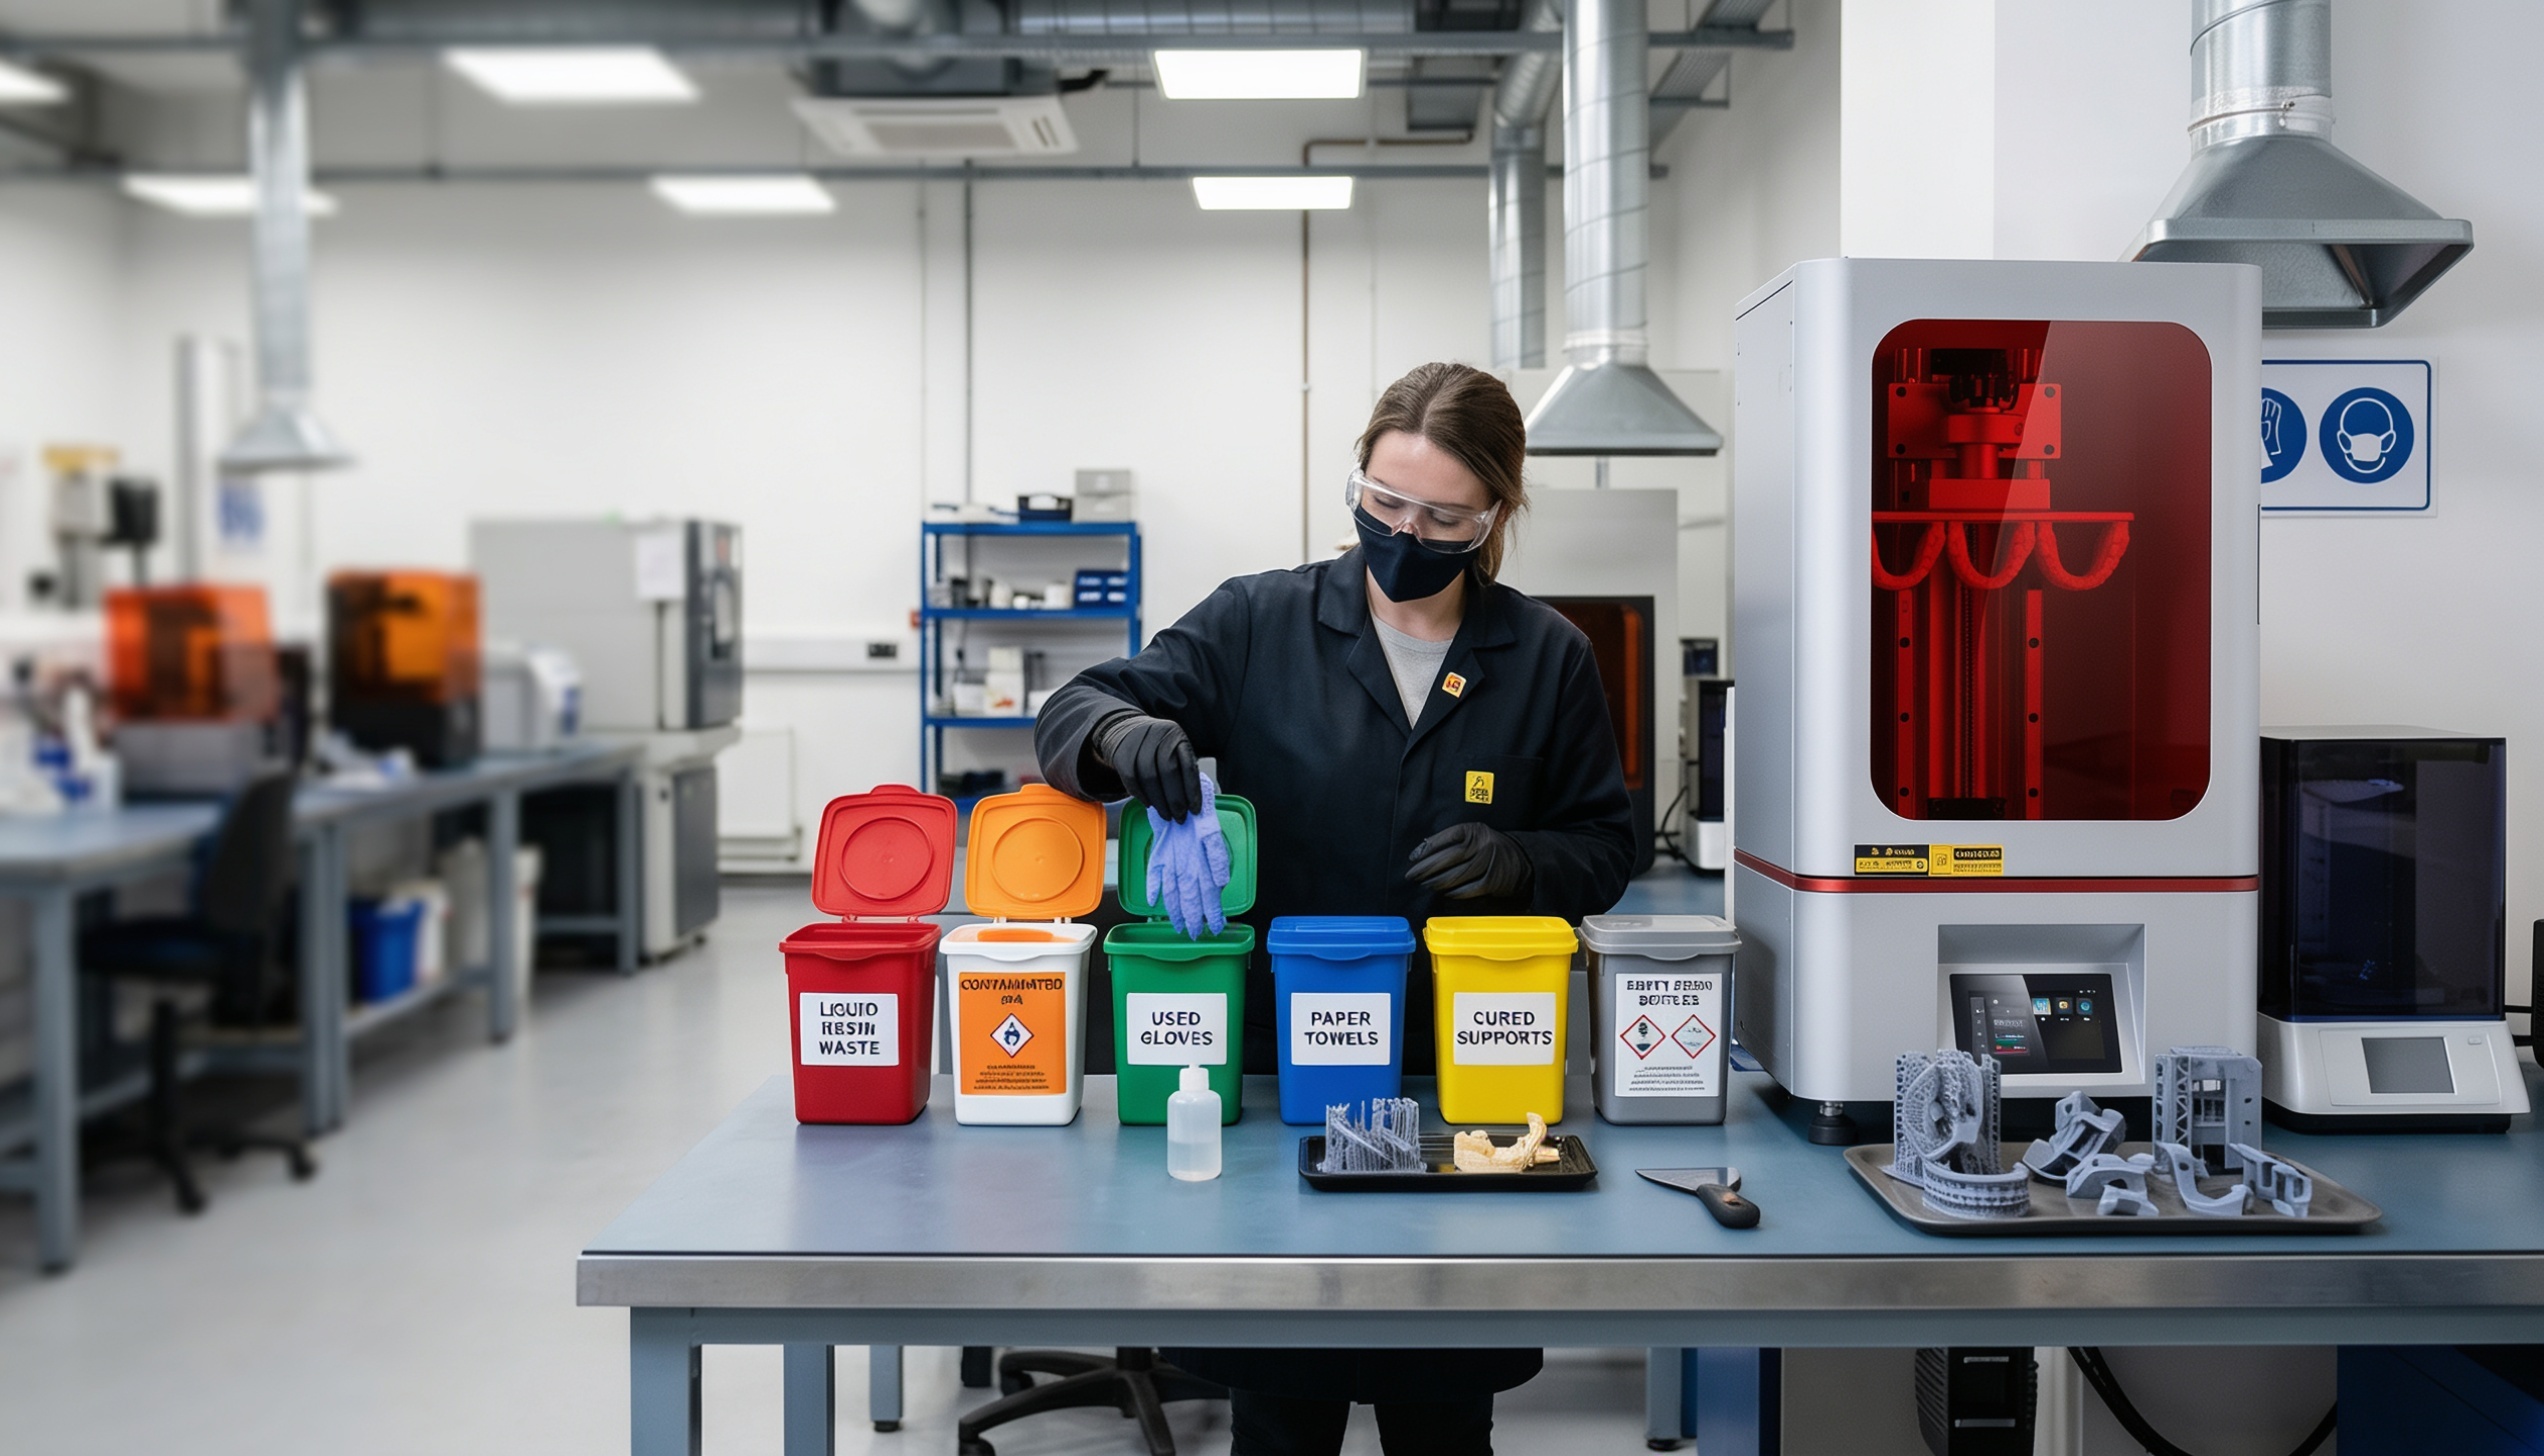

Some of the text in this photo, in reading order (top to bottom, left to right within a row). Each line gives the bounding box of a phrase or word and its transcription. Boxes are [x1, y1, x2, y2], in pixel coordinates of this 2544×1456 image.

[1152, 1011, 1201, 1026] USED
[1311, 1011, 1371, 1026] PAPER
[1473, 1011, 1535, 1026] CURED
[1140, 1031, 1213, 1046] GLOVES
[1304, 1031, 1379, 1046] TOWELS
[1456, 1031, 1553, 1046] SUPPORTS
[818, 1040, 881, 1056] WASTE
